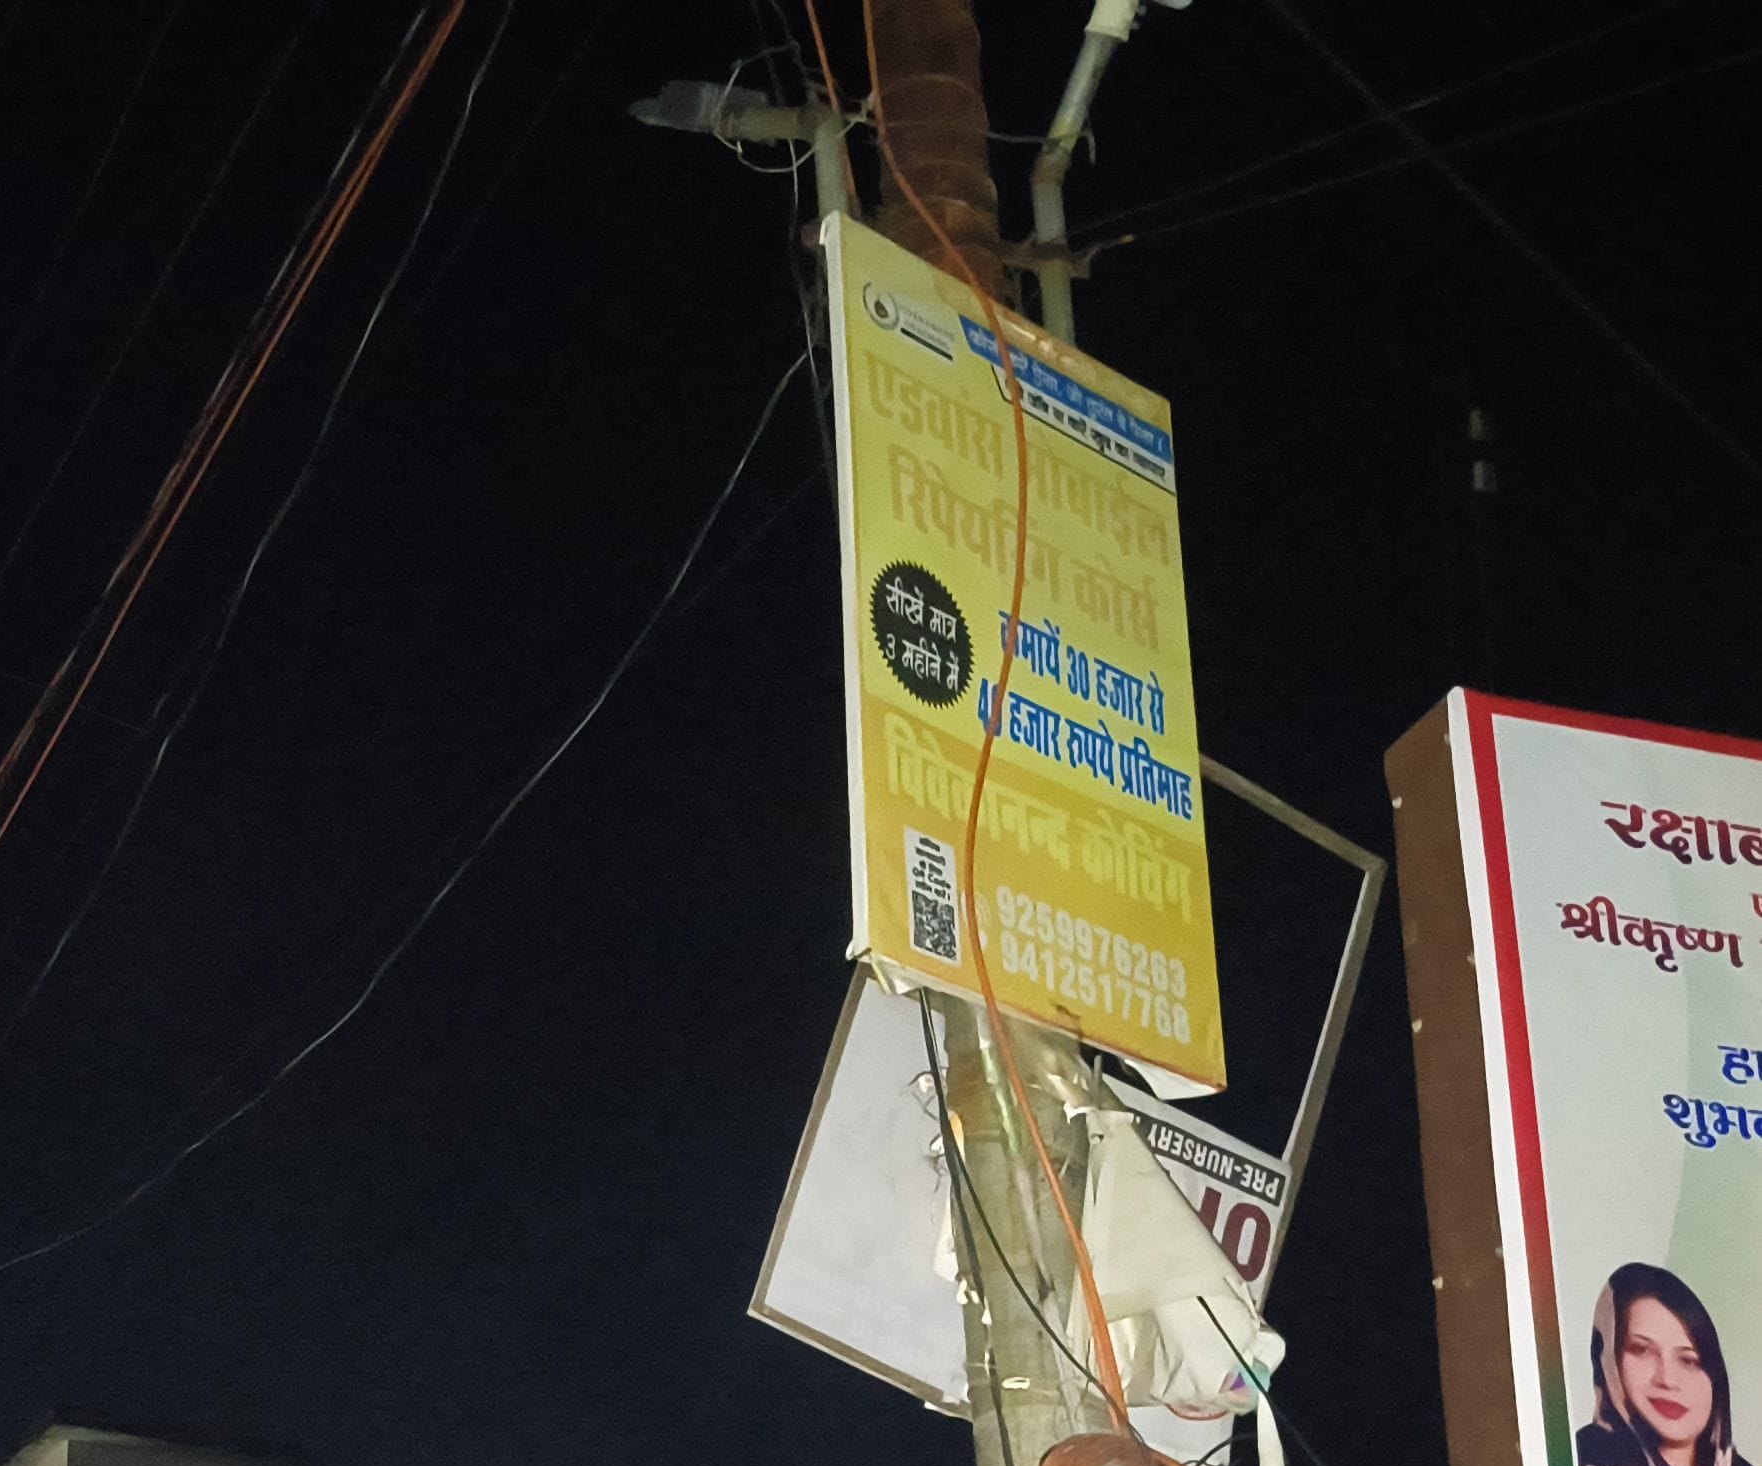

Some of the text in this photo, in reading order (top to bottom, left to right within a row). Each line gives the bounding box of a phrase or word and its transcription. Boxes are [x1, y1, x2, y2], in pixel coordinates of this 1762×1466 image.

[885, 575, 958, 643] सीखें मात्र
[901, 636, 942, 685] महीने
[945, 650, 961, 692] में
[1066, 644, 1090, 701] 30
[1093, 657, 1145, 726] हजार
[1147, 670, 1165, 735] से
[1008, 691, 1061, 761] हजार
[1117, 736, 1192, 821] प्रतिमाह
[1555, 895, 1745, 973] श्रीकृष्ण
[1147, 1122, 1281, 1201] PRE-NURSERY
